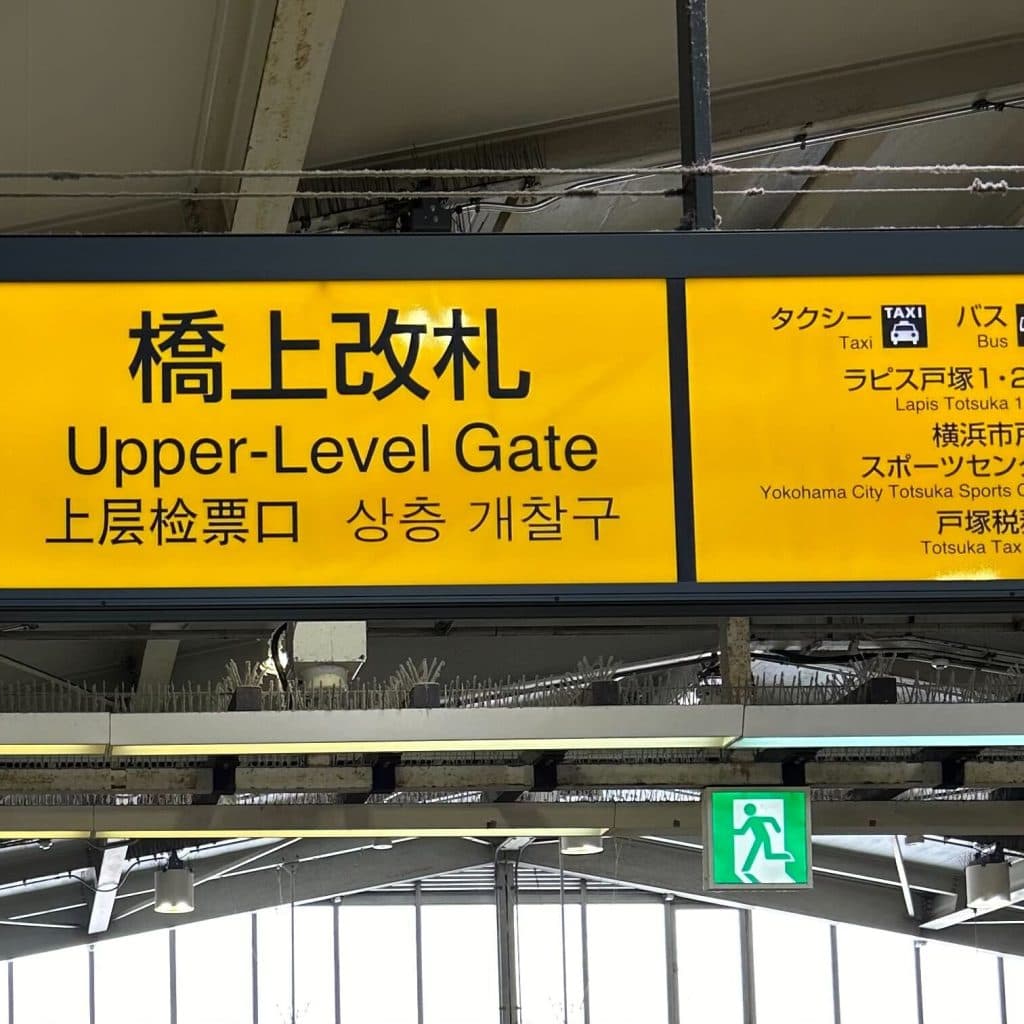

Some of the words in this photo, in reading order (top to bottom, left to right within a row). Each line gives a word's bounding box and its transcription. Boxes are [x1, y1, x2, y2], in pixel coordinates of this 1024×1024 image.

[771, 307, 872, 330] タクシー
[884, 307, 923, 319] TAXI
[956, 304, 1008, 328] バス
[840, 335, 873, 350] Taxi
[978, 335, 1008, 349] Bus
[128, 308, 532, 404] 橋上改札
[895, 397, 939, 415] Lapis
[944, 397, 1009, 411] Totsuka
[67, 424, 430, 488] Upper-Level
[455, 423, 598, 473] Gate
[861, 455, 1024, 479] スポーツセン
[760, 485, 847, 500] Yokohama
[852, 485, 883, 502] City
[888, 484, 953, 499] Totsuka
[959, 484, 1011, 501] Sports
[45, 496, 300, 546] 上层检票口
[346, 496, 446, 543] 상층
[469, 494, 621, 541] 개찰구
[936, 510, 1024, 535] 戸塚税
[921, 540, 986, 555] Totsuka
[992, 540, 1022, 554] Tax
